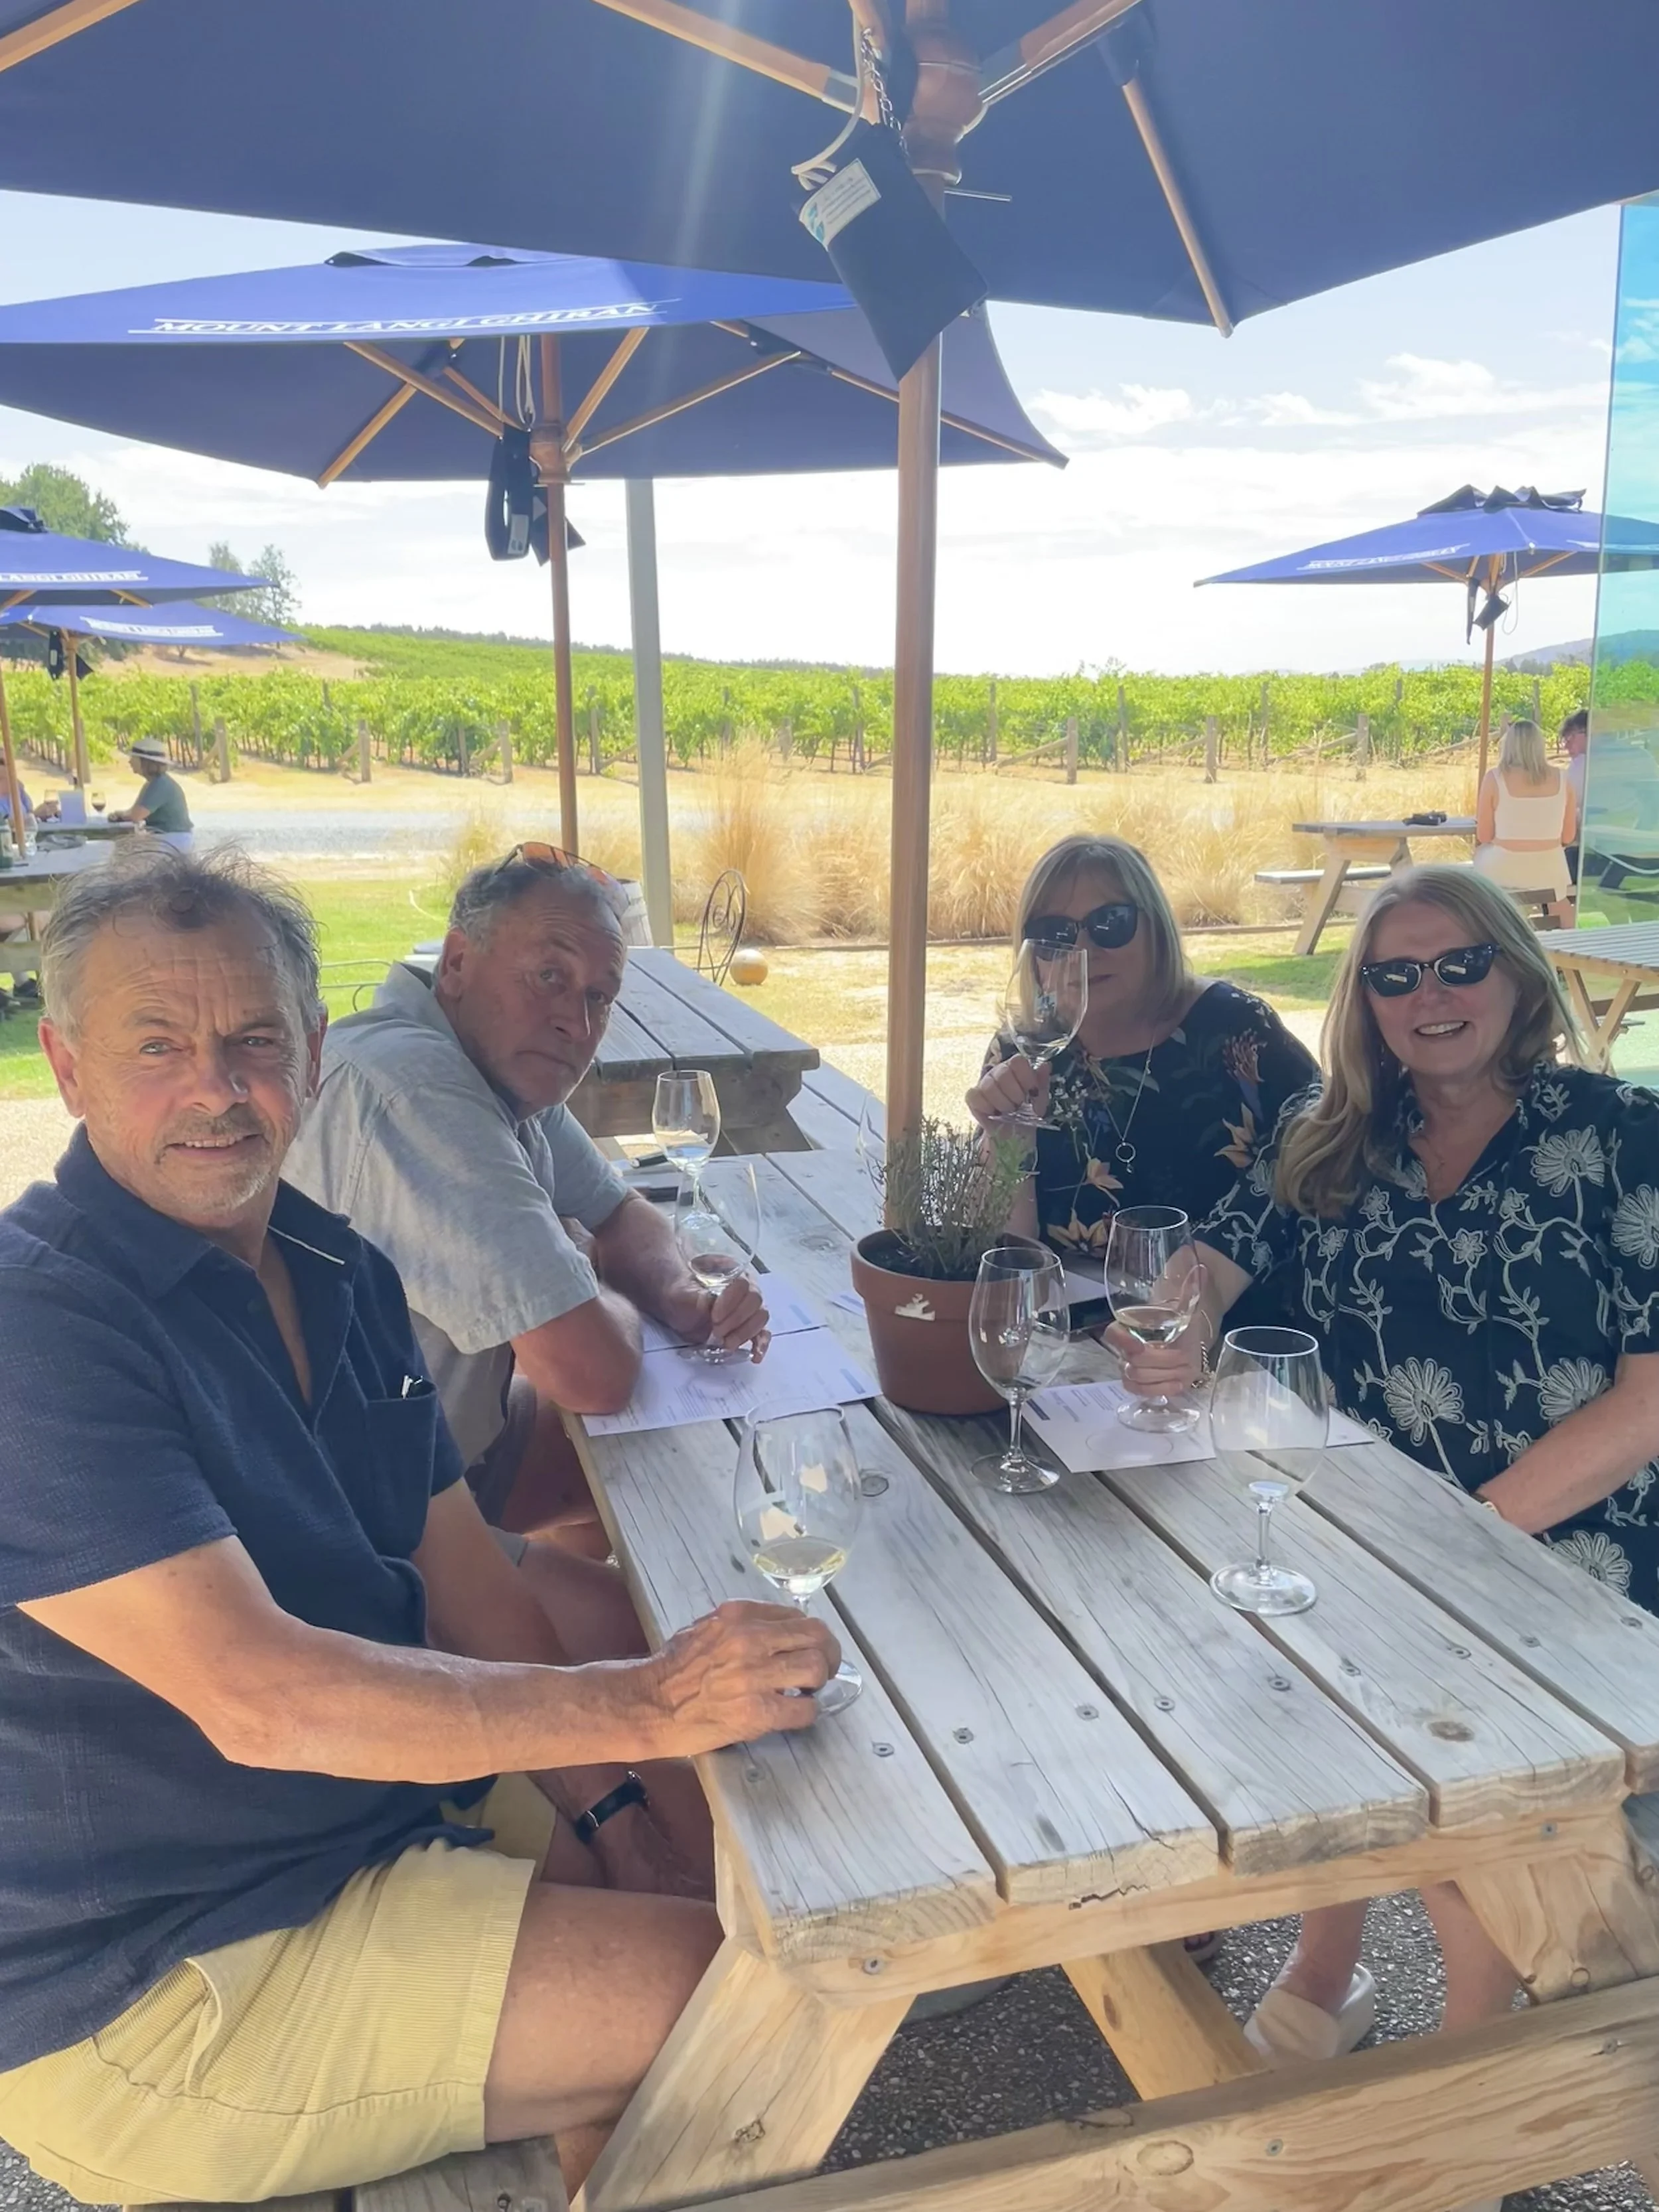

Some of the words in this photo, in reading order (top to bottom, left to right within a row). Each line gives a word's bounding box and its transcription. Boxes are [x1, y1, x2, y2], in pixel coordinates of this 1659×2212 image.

[151, 322, 323, 332] MOUNT
[328, 319, 468, 331] LANGI
[480, 305, 657, 325] GHIRAN
